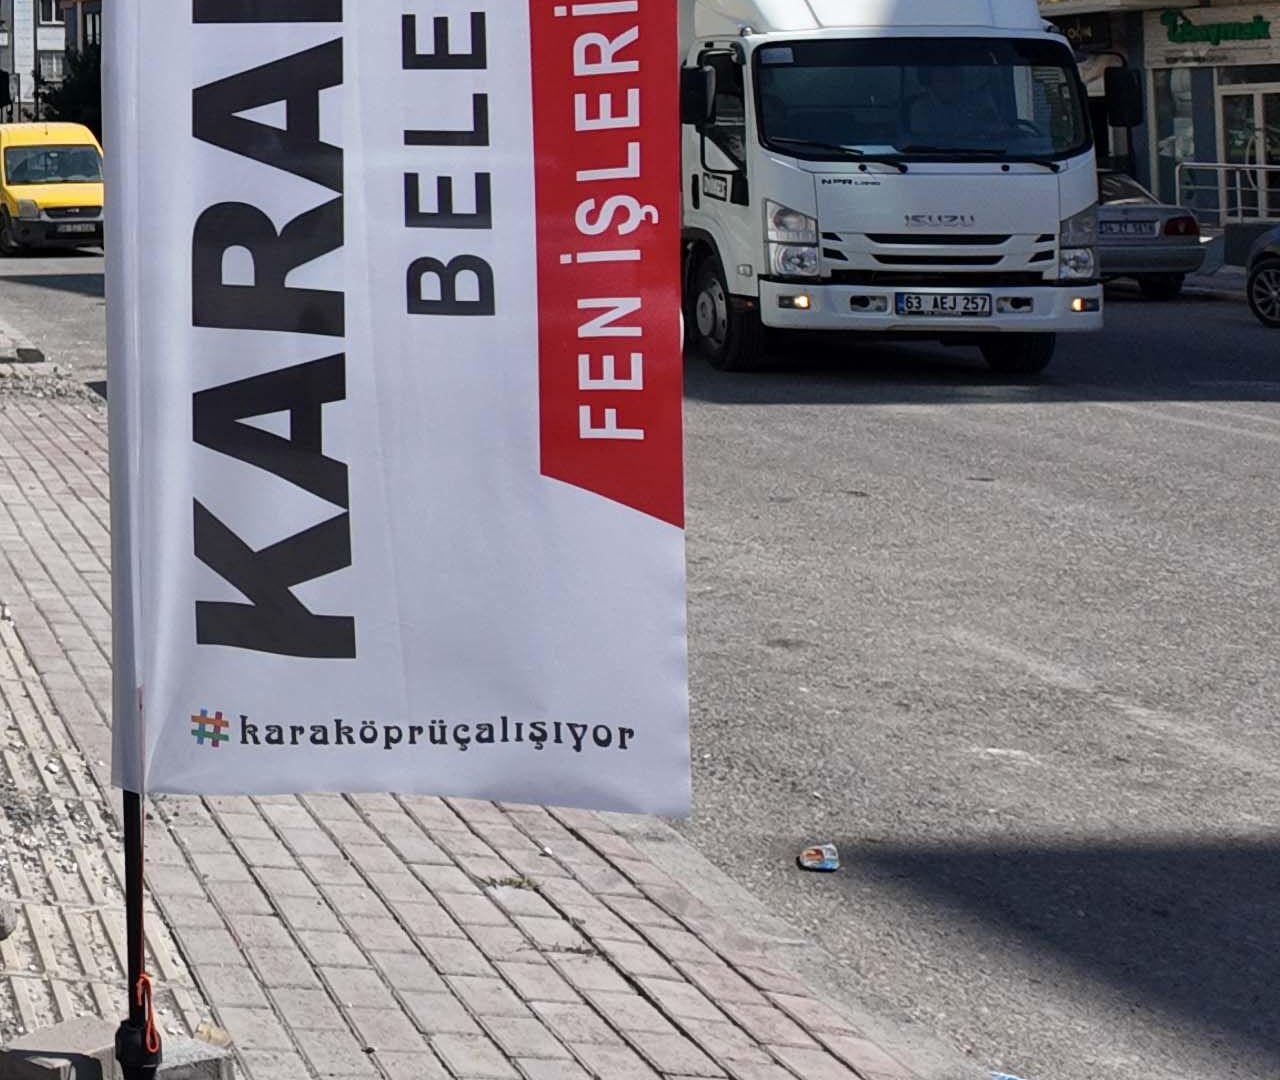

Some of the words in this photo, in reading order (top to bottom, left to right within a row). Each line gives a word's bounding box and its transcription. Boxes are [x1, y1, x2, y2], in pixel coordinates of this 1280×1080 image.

[553, 0, 660, 265] İŞLERİ
[904, 214, 976, 228] ISUZU
[905, 296, 922, 310] 63
[932, 296, 957, 310] AEJ
[962, 296, 988, 310] 257
[577, 297, 644, 441] FEN
[190, 707, 636, 753] #karaköprüçalışıyor
